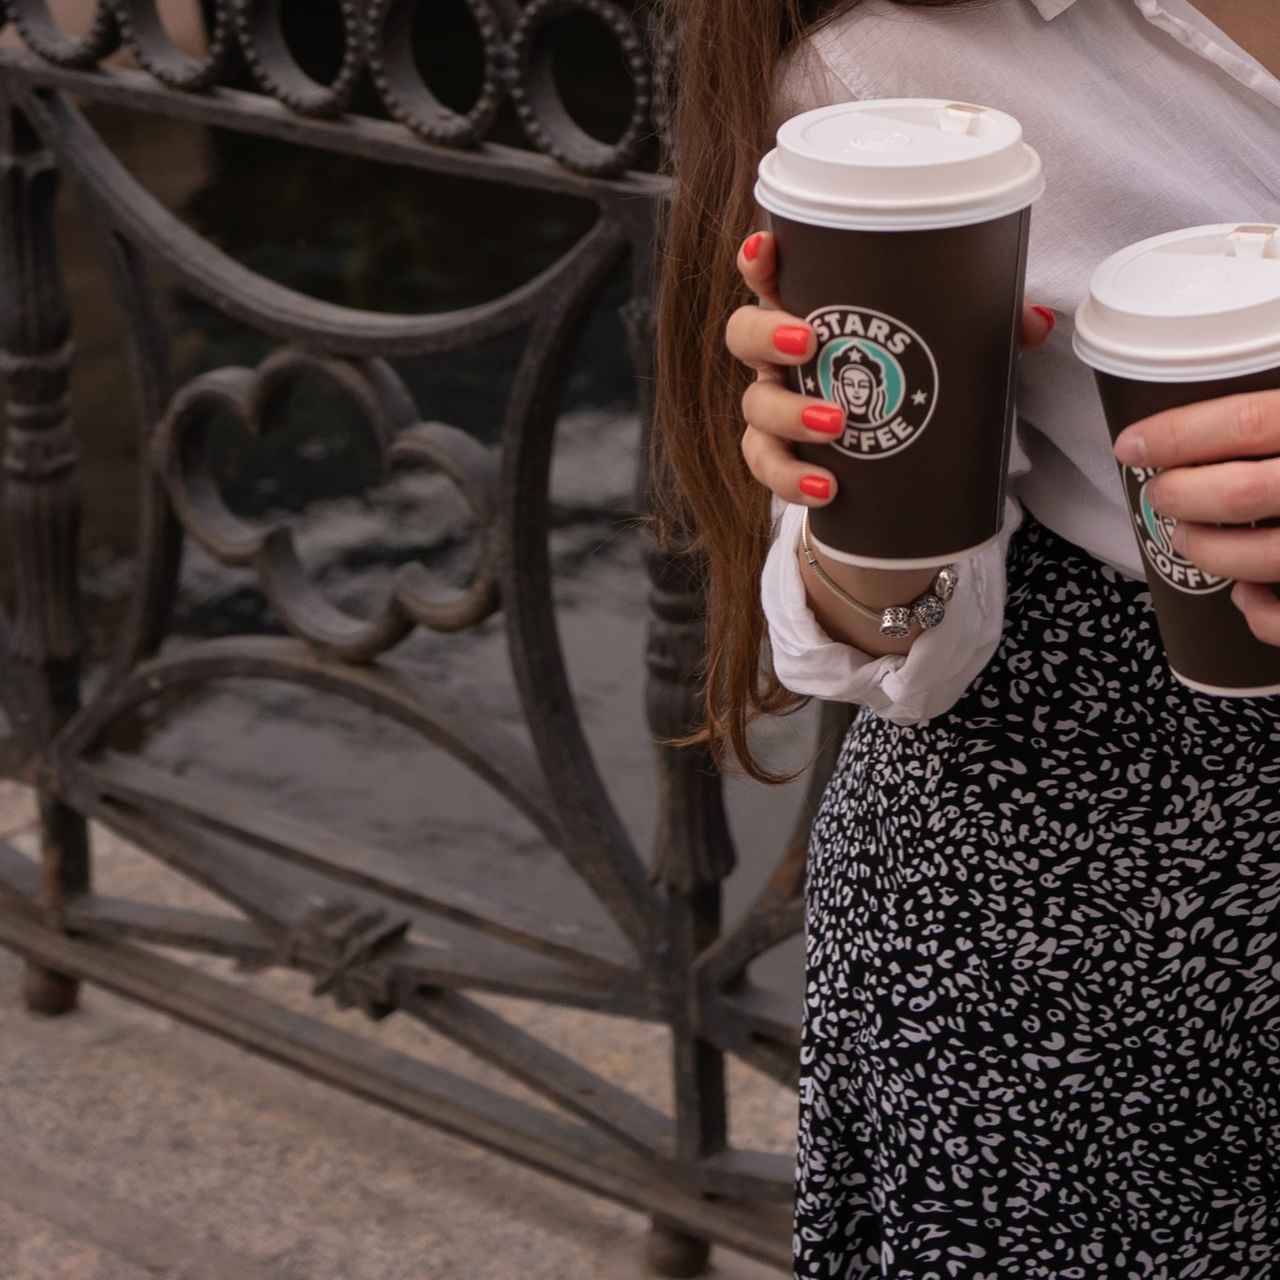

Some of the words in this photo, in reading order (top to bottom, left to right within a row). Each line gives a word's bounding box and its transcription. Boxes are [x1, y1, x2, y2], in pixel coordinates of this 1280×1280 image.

[812, 311, 912, 355] STARS
[842, 416, 914, 452] FFEE
[1145, 539, 1221, 588] COFF
